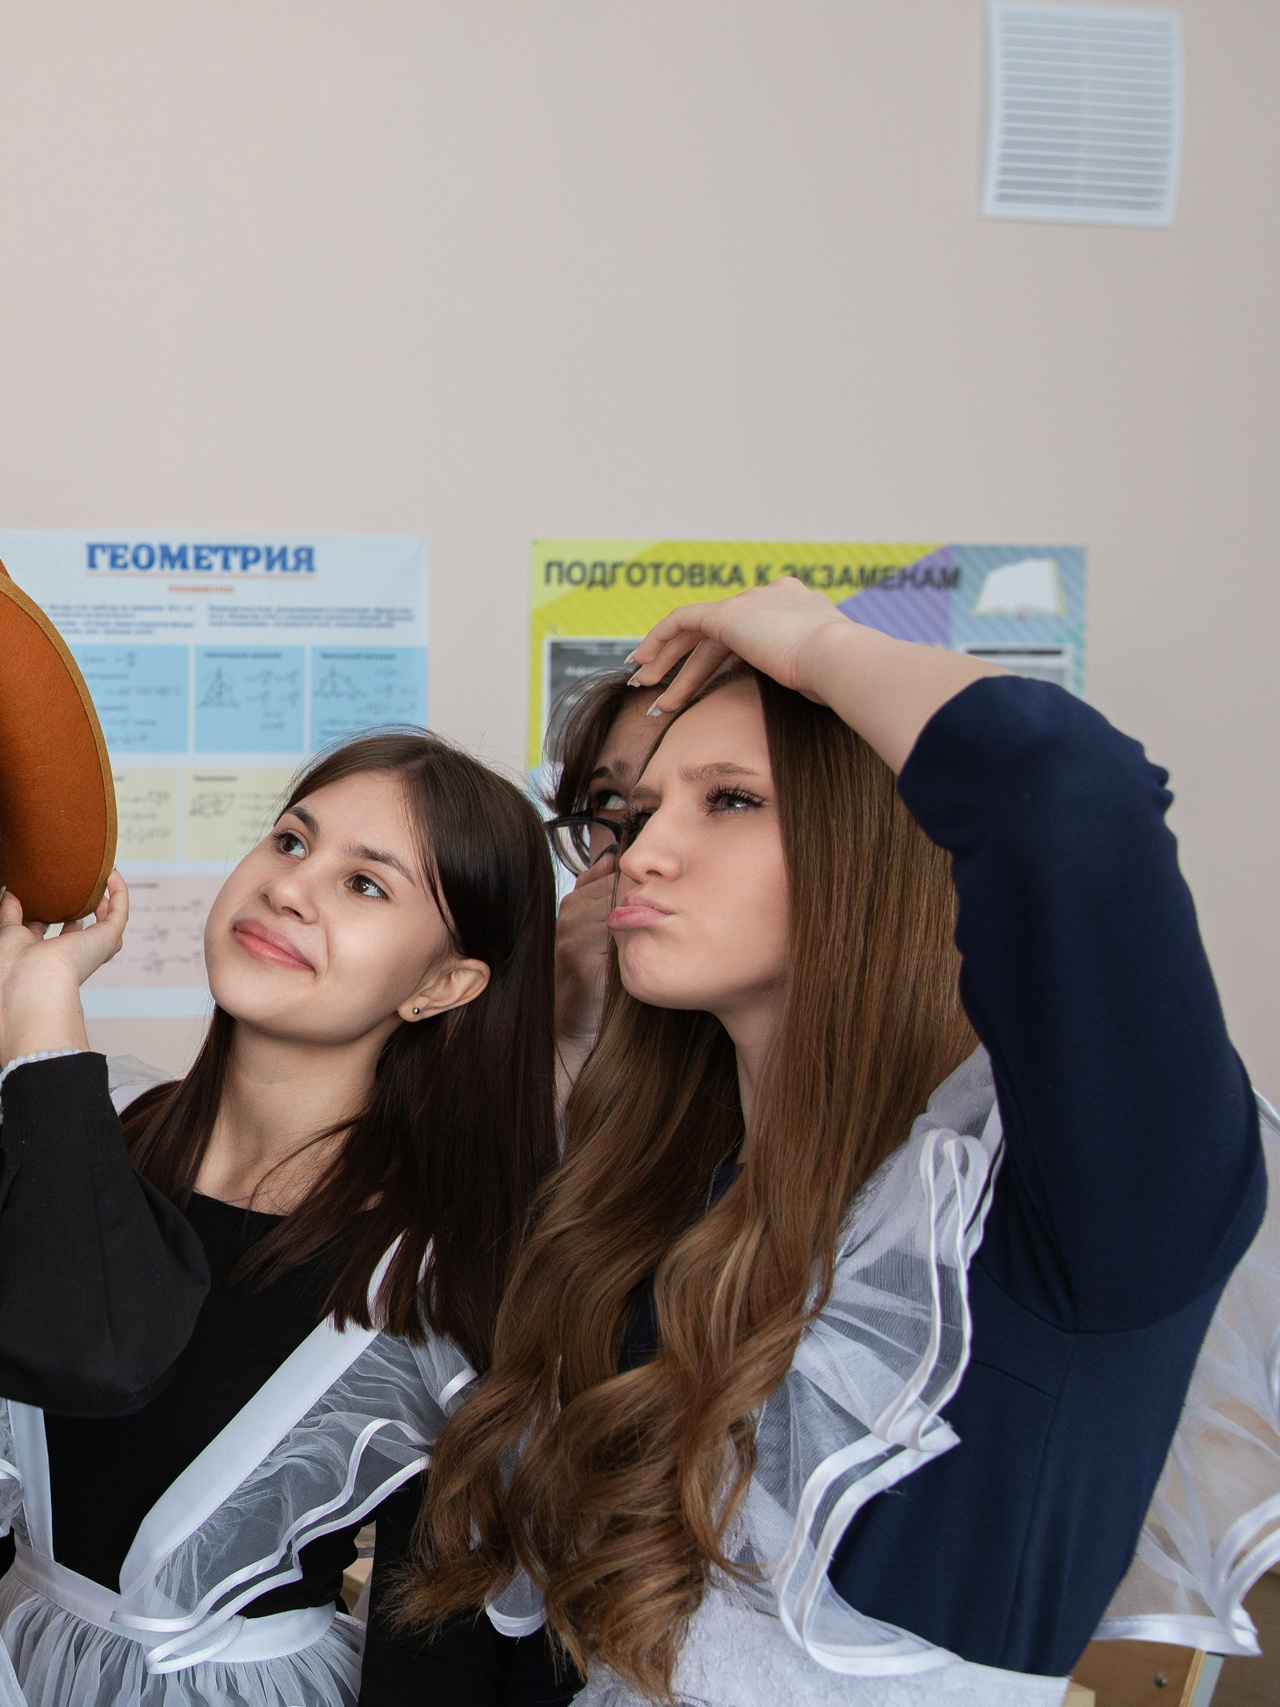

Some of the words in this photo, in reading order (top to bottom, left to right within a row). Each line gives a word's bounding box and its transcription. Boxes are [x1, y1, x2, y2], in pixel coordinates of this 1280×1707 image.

[85, 543, 316, 572] ГЕОМЕТРИЯ
[544, 561, 745, 590] ПОДГОТОВКА
[754, 563, 773, 587] К
